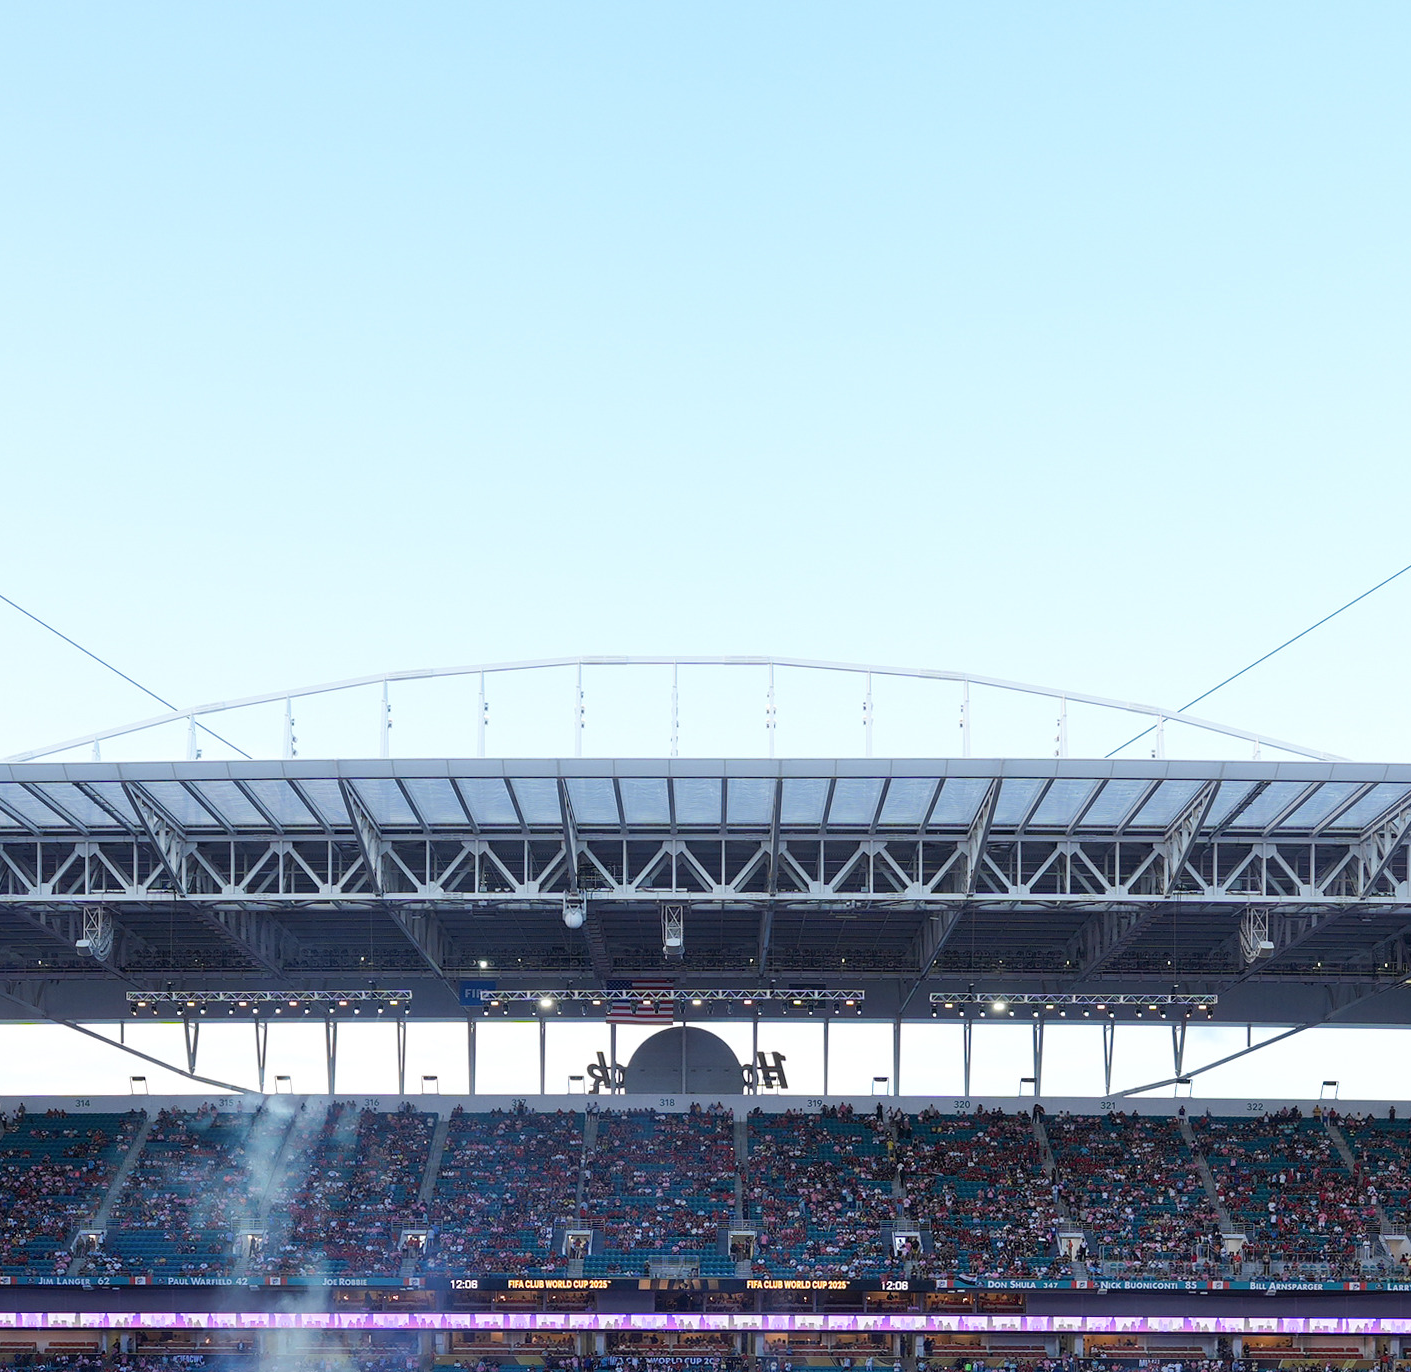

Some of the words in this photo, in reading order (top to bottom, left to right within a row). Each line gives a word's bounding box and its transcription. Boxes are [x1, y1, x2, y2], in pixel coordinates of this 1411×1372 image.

[75, 1099, 91, 1108] 314
[219, 1098, 234, 1107] 315
[364, 1098, 380, 1107] 316
[659, 1098, 675, 1107] 318
[807, 1099, 823, 1108] 319
[953, 1100, 971, 1109] 320
[1100, 1101, 1116, 1110] 321
[1246, 1102, 1263, 1111] 322
[38, 1278, 53, 1286] JIM
[97, 1277, 110, 1286] 62
[168, 1277, 189, 1286] PAUL
[191, 1277, 232, 1286] WARFIELD
[235, 1277, 248, 1286] 42
[322, 1278, 338, 1287] JOE
[339, 1278, 367, 1287] ROBBIE
[508, 1279, 524, 1289] FIFA
[525, 1279, 544, 1289] CLUB
[545, 1279, 572, 1289] WORLD
[573, 1279, 588, 1289] CUP
[746, 1279, 762, 1289] FIFA
[763, 1279, 783, 1289] CLUB
[784, 1279, 811, 1289] WORLD
[812, 1279, 827, 1289] CUP
[988, 1281, 1007, 1289] DON
[1009, 1281, 1036, 1289] SHULA
[1100, 1281, 1121, 1290] NICK
[1124, 1281, 1178, 1290] BUONICONTI
[1184, 1281, 1197, 1290] 85
[1249, 1282, 1267, 1291] BILL
[1269, 1283, 1323, 1292] ARNSPARGER
